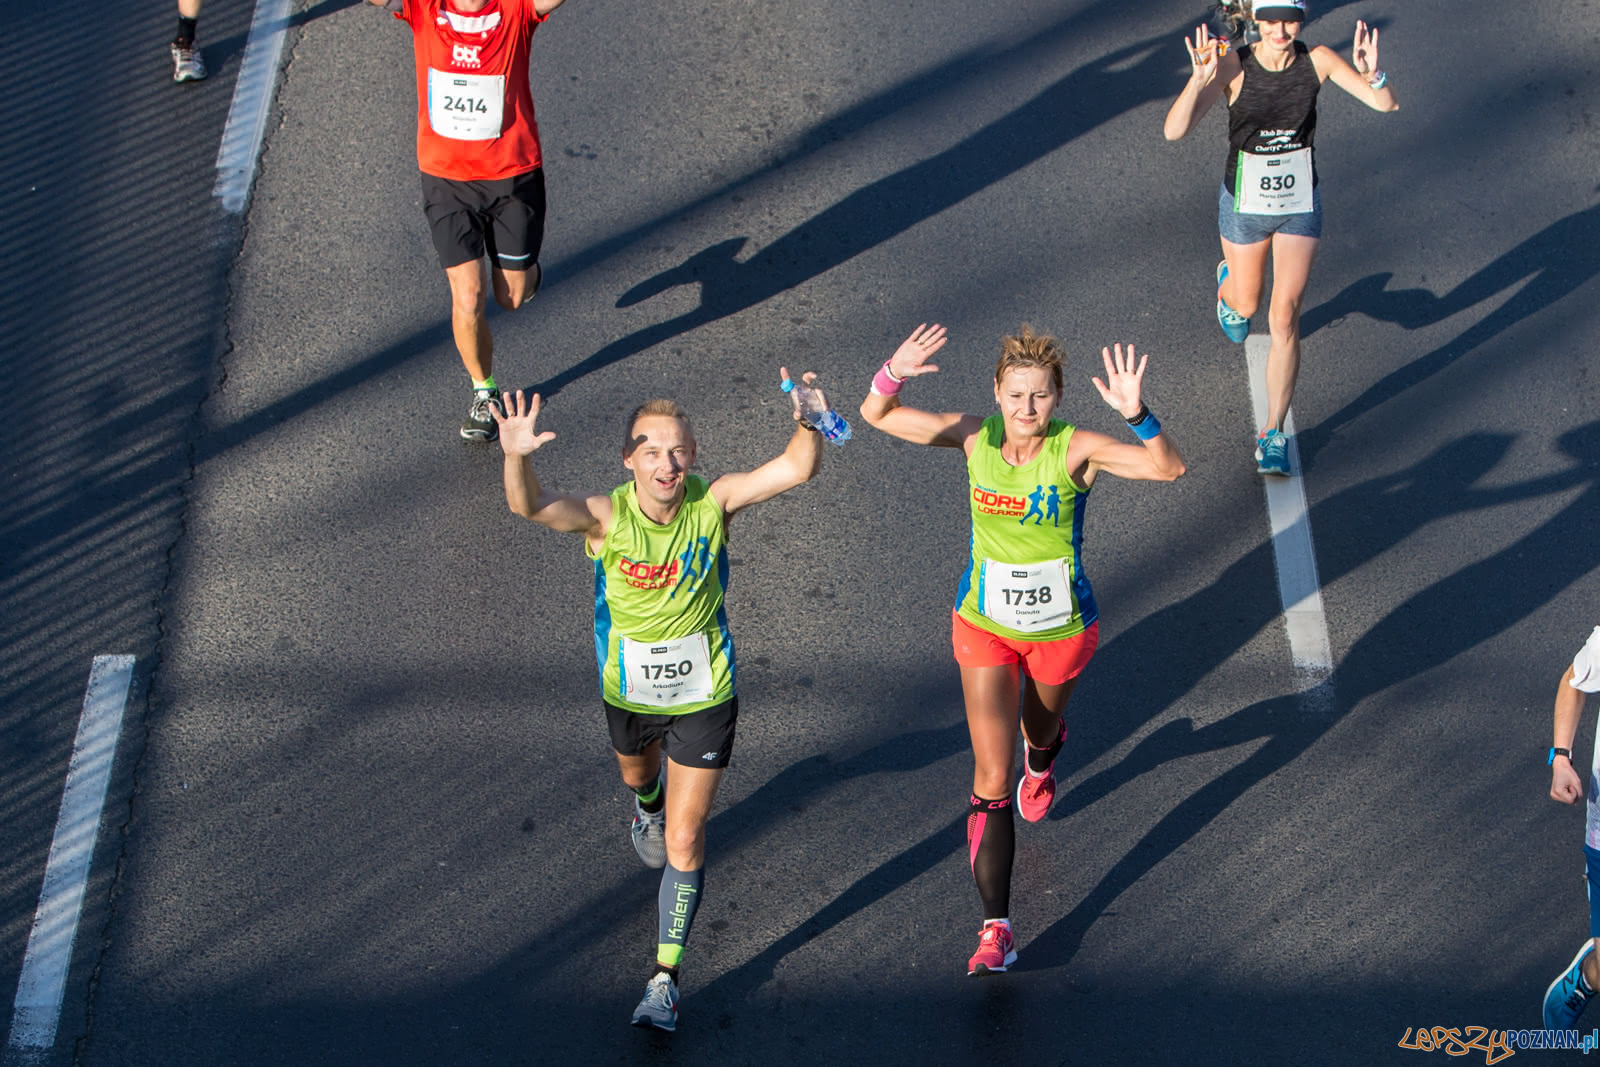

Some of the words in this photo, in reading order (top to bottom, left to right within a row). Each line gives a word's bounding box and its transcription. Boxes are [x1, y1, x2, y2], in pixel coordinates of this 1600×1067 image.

[444, 95, 487, 113] 2414
[1260, 174, 1295, 190] 830
[1002, 586, 1052, 606] 1738
[641, 660, 692, 680] 1750
